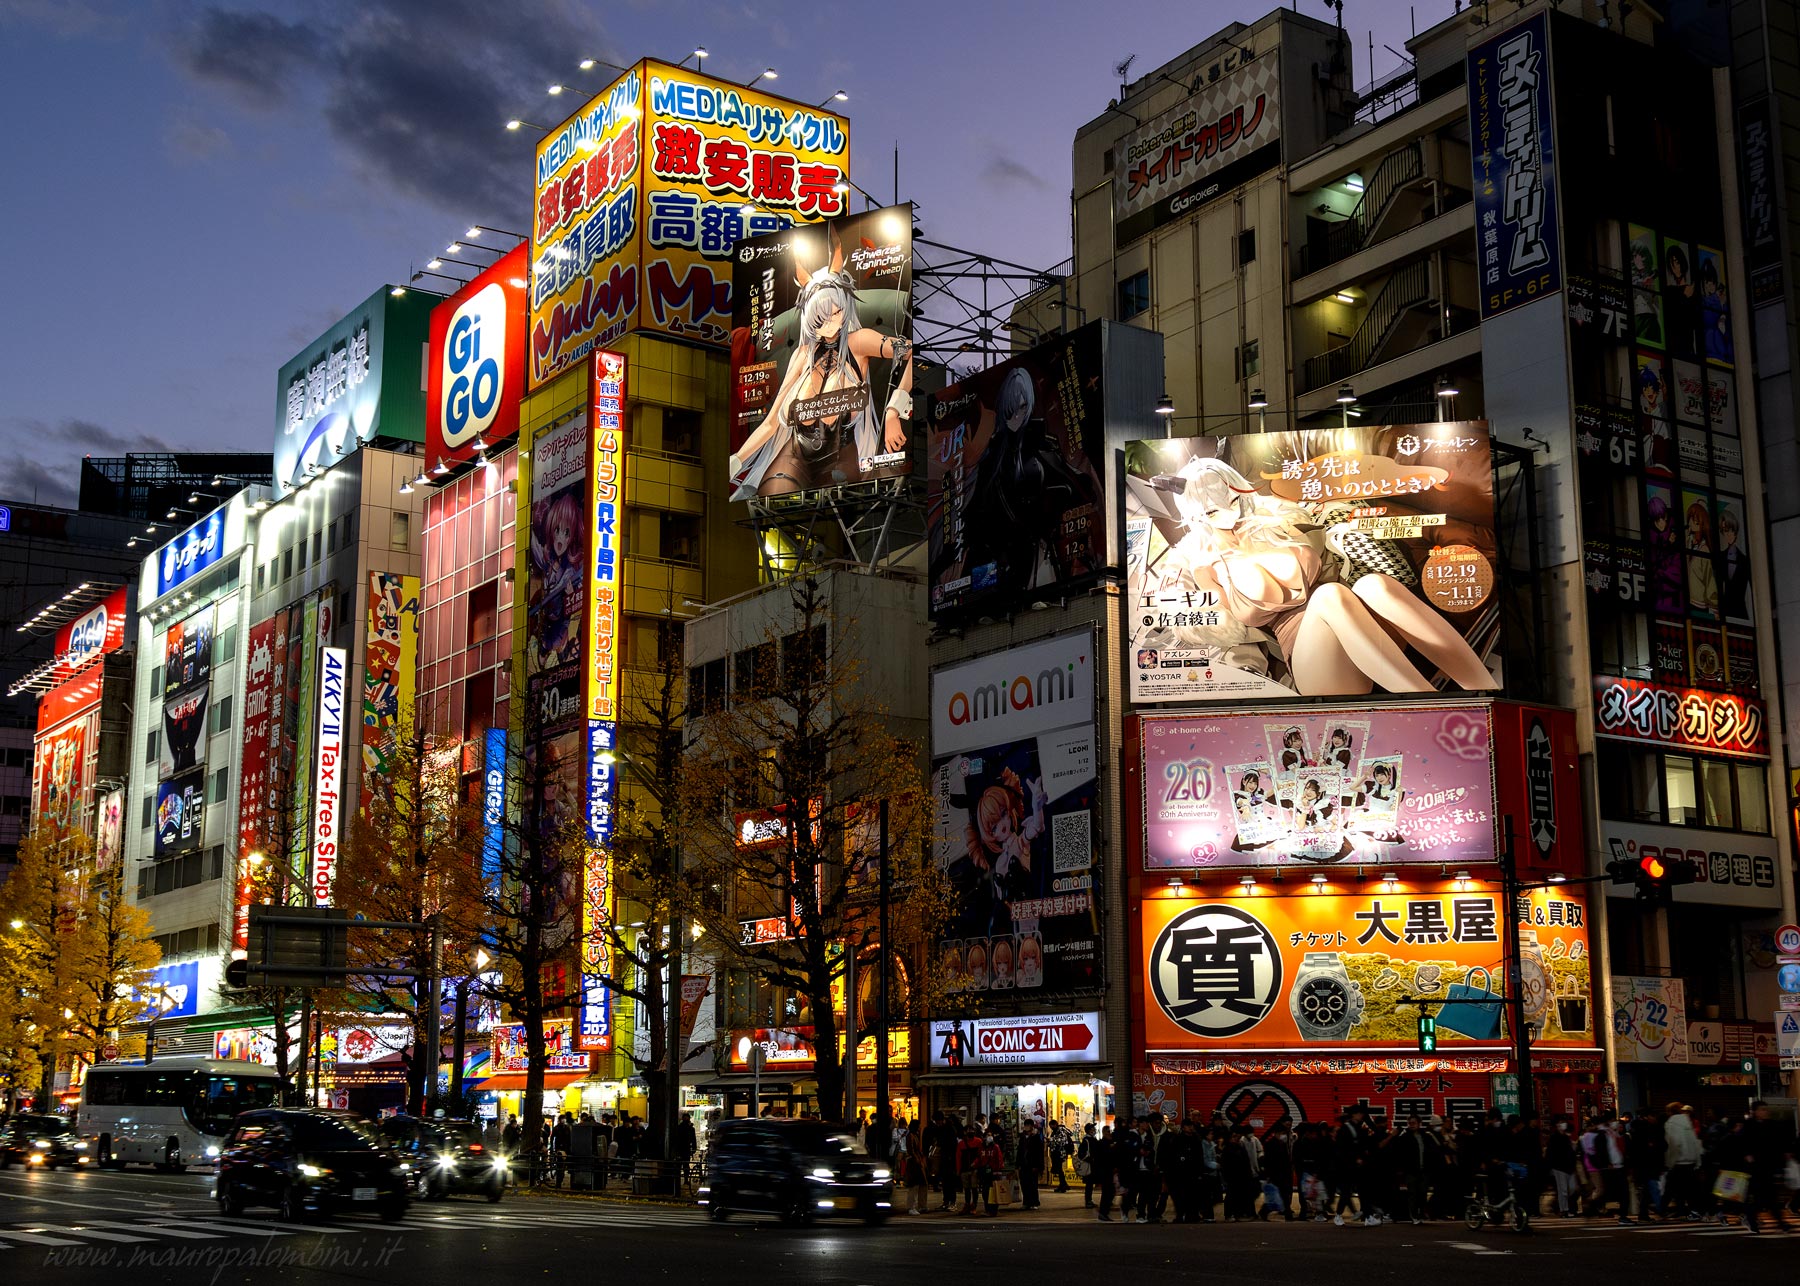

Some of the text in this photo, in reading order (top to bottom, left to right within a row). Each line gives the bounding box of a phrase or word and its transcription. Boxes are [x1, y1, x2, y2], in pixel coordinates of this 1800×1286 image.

[650, 77, 845, 153] MEDIAリサイクル
[1128, 94, 1266, 201] メイドカジノ
[537, 119, 637, 244] 激安販売
[651, 121, 844, 217] 激安販売
[534, 184, 636, 310] 高額買取
[1482, 209, 1500, 286] 秋葉原店
[532, 262, 638, 382] Mulan
[1600, 307, 1629, 339] 7F
[600, 381, 620, 395] 買取
[600, 398, 619, 410] 販売
[600, 414, 619, 428] 市場
[1609, 436, 1637, 466] 6F
[541, 461, 563, 490] Angel
[1281, 458, 1361, 481] 誘う先は
[1436, 564, 1476, 579] 12.19
[1140, 590, 1219, 608] エーギル
[1617, 571, 1646, 602] 5F
[1158, 611, 1220, 628] 佐倉綾音
[593, 586, 615, 716] 中央通りホビー館
[323, 651, 342, 722] AKKY
[1150, 673, 1182, 681] YOSTAR
[949, 663, 1074, 726] amiami
[1600, 685, 1762, 748] メイドカジノ
[313, 741, 340, 900] Tax-free Shop
[1177, 810, 1218, 819] Anniversary
[1011, 893, 1094, 921] 好評予約受付中!
[1355, 898, 1499, 946] 大黒屋
[1290, 930, 1348, 947] チケット
[1782, 932, 1799, 946] 40
[1166, 922, 1271, 1021] 質
[1028, 1017, 1050, 1026] Magazine
[1616, 1018, 1629, 1033] 2F
[1645, 1000, 1668, 1027] 22
[980, 1027, 1063, 1052] COMIC ZIN
[978, 1054, 1026, 1064] Akihabara
[1153, 1058, 1203, 1073] 高価買取
[1454, 1057, 1507, 1071] 無料査定
[1374, 1076, 1453, 1094] チケット
